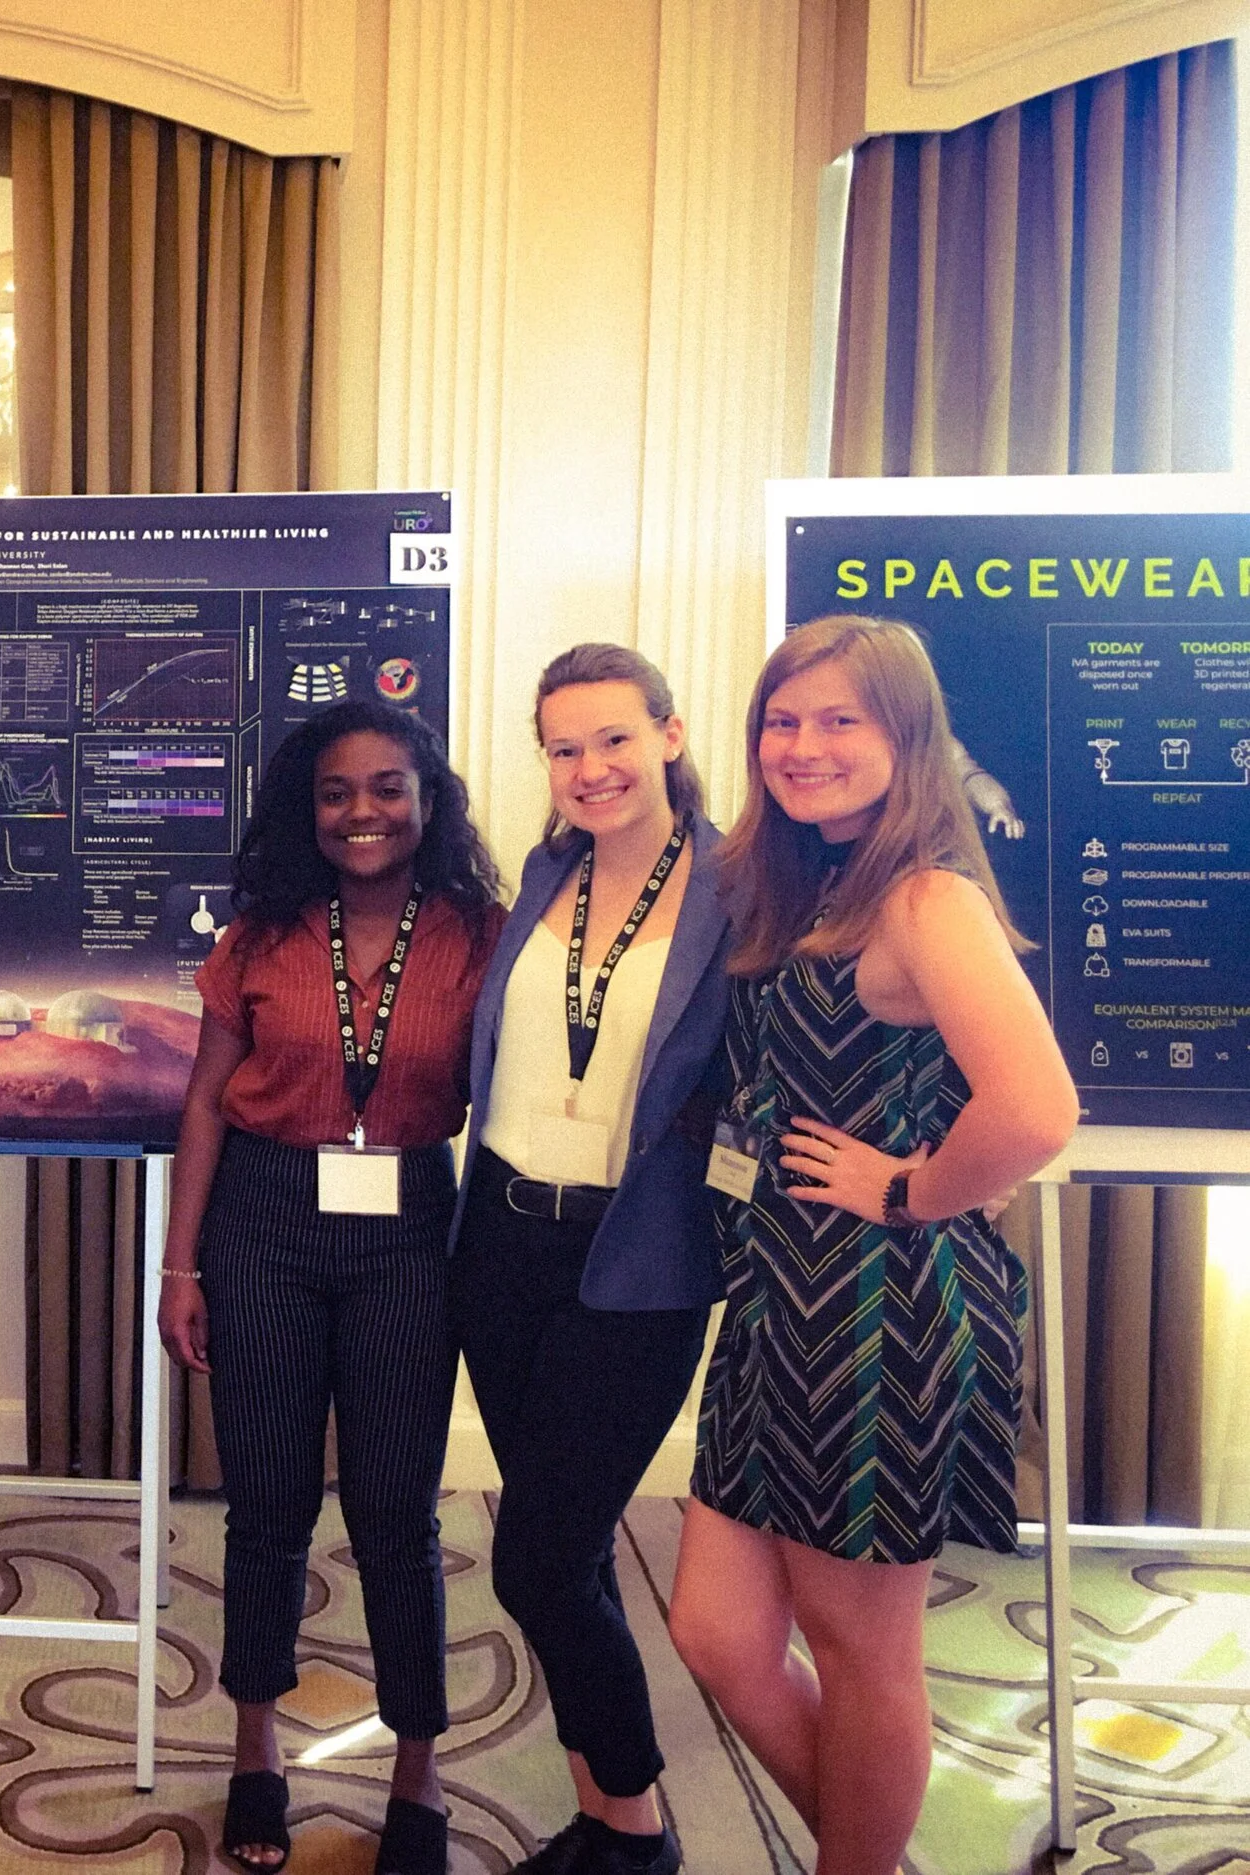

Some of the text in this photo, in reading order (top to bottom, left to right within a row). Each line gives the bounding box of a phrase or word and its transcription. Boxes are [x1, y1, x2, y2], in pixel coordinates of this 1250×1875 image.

[31, 531, 136, 541] SUSTAINABLE
[142, 530, 174, 540] AND
[182, 529, 267, 540] HEALTHIER
[275, 528, 329, 538] LIVING
[401, 546, 448, 571] D3
[1087, 642, 1144, 654] TODAY
[1071, 658, 1089, 667] IVA
[1091, 659, 1141, 669] garments
[1194, 658, 1235, 667] Clothes
[1078, 670, 1125, 680] disposed
[1193, 669, 1249, 681] 3D printed
[1086, 718, 1124, 728] PRINT
[1156, 718, 1197, 728] WEAR
[1153, 793, 1202, 803] REPEAT
[1121, 843, 1230, 852] PROGRAMMABLE SIZE
[655, 855, 672, 879] ICES
[1121, 871, 1207, 880] PROGRAMMABLE
[1122, 899, 1209, 908] DOWNLOADABLE
[575, 905, 585, 928] ICES
[632, 898, 649, 923] ICES
[1122, 929, 1172, 937] EVA SUITS
[394, 939, 406, 962] ICES
[607, 942, 624, 966] ICES
[333, 950, 343, 971] ICES
[568, 951, 579, 974] ICES
[1123, 958, 1211, 967] TRANSFORMABLE
[383, 982, 395, 1005] ICES
[338, 993, 349, 1015] ICES
[592, 990, 603, 1015] ICES
[568, 1001, 579, 1024] ICES
[1094, 1004, 1176, 1015] EQUIVALENT
[1180, 1005, 1229, 1016] SYSTEM
[371, 1028, 384, 1052] ICES
[344, 1040, 356, 1062] ICES
